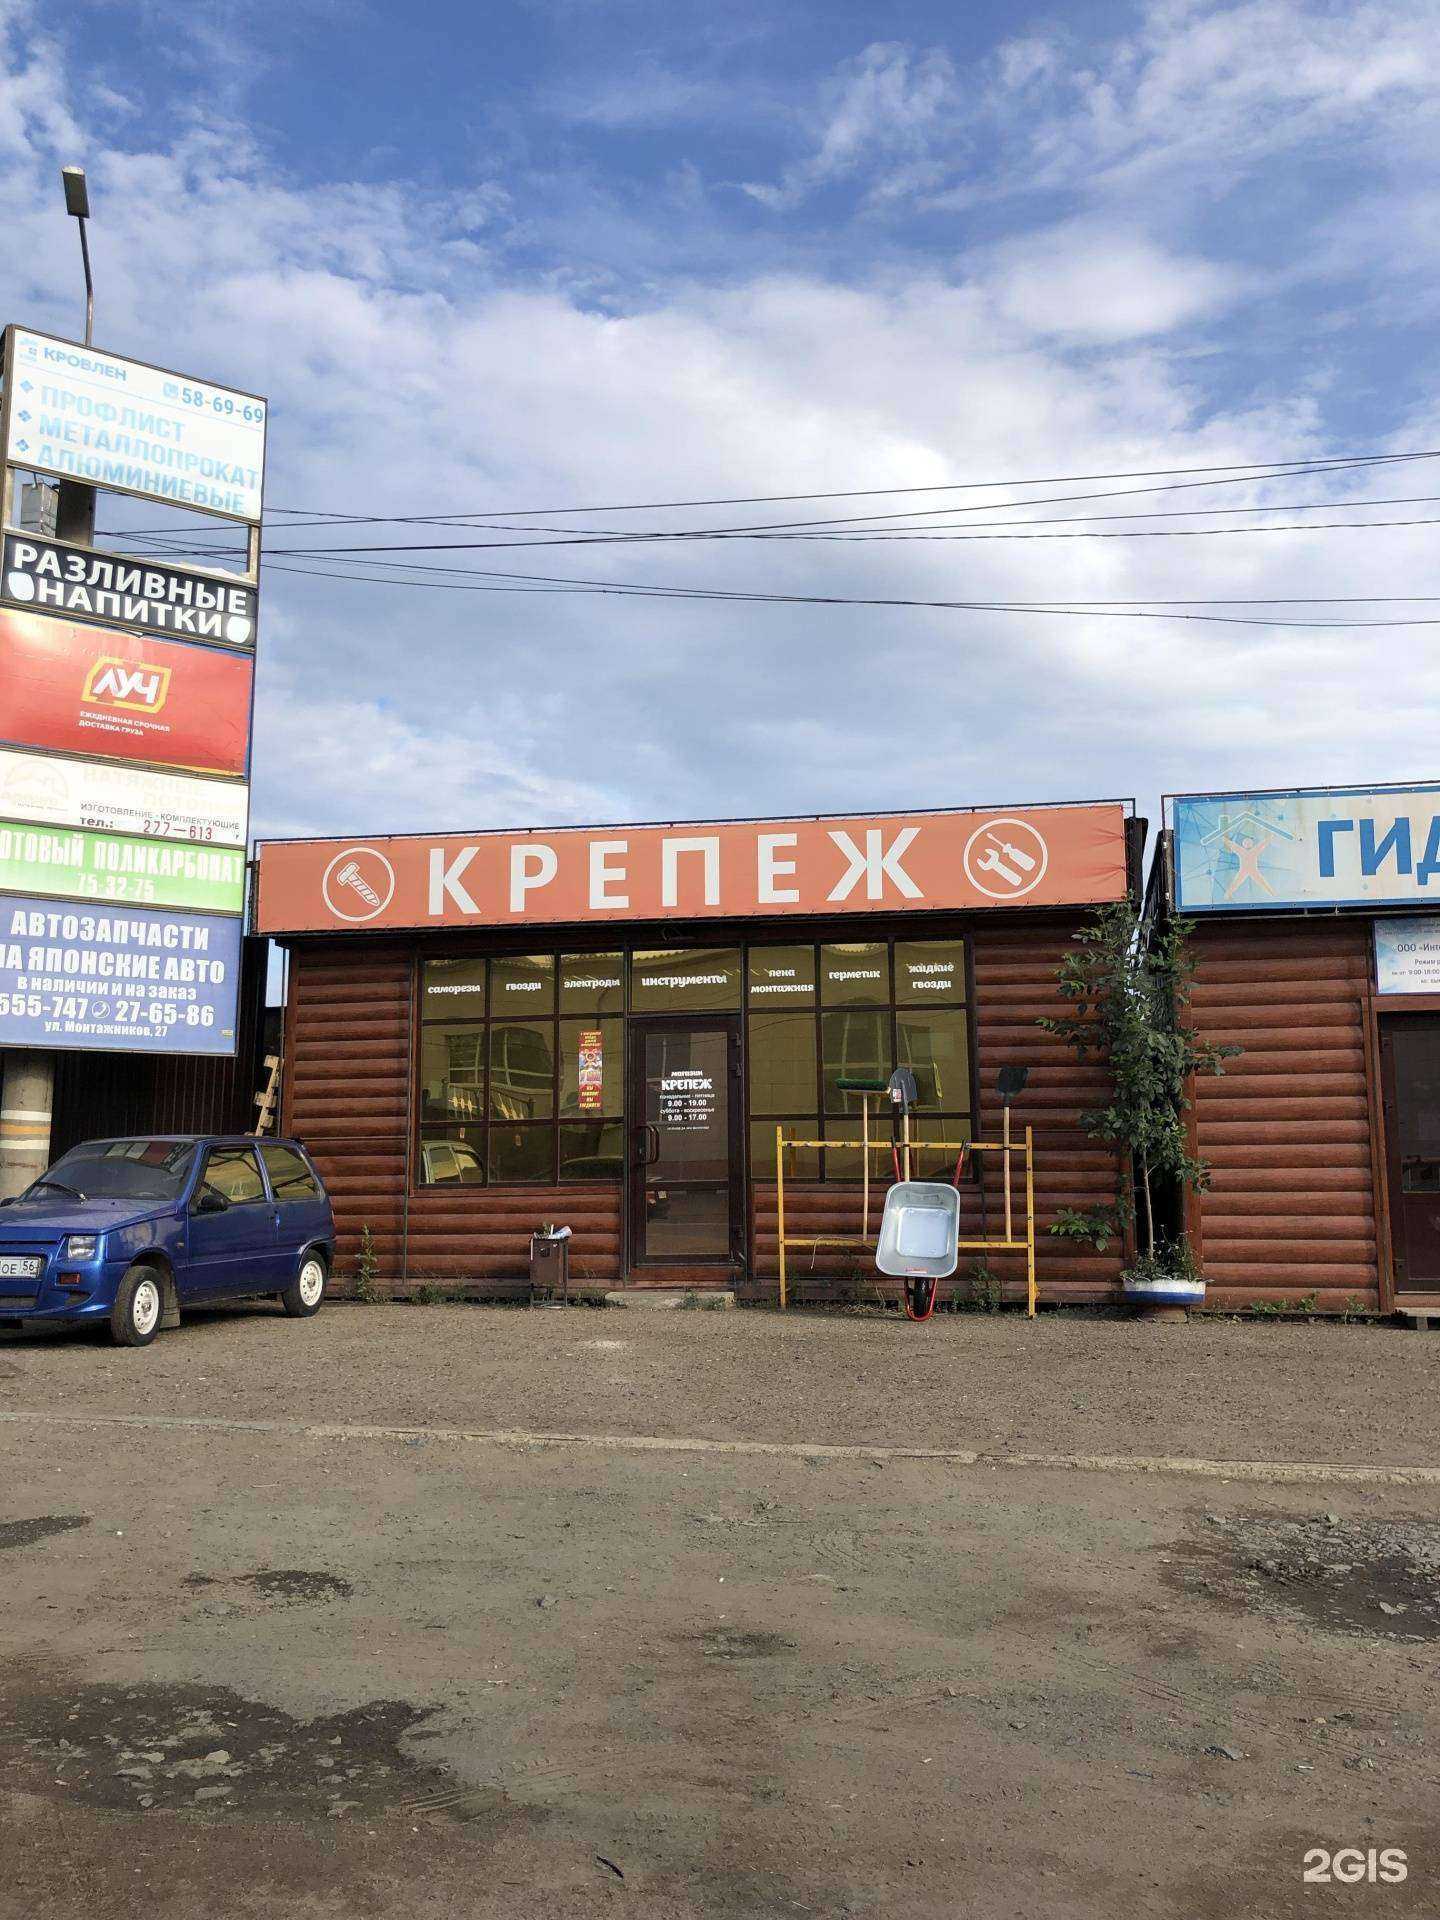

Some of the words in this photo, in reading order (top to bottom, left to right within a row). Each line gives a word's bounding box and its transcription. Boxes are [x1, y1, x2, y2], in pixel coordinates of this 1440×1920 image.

[44, 347, 127, 382] КРОВЛЕН
[41, 384, 186, 443] ПРОФЛИСТ
[182, 387, 263, 424] 58-69-69
[39, 414, 259, 491] МЕТАЛЛОПРОКАТ
[37, 444, 246, 515] АЛЮМИНИЕВЫЕ
[13, 542, 248, 616] РАЗЛИВНЫЕ
[37, 577, 223, 638] НАПИТКИ
[92, 667, 160, 704] ЛУЧ
[78, 719, 121, 733] ДОСТАВКА
[80, 803, 153, 819] ИЗГОТОВЛЕНИЕ
[160, 813, 240, 830] КОМПЛЕКТУЮЩИЕ
[94, 841, 243, 884] ПОЛИКАРБОНАТ
[428, 826, 925, 916] КРЕПЕЖ
[10, 910, 209, 951] АВТОЗАПЧАСТИ
[27, 946, 160, 980] ЯПОНСКИЕ
[164, 955, 225, 984] АВТО
[768, 968, 796, 978] пена
[828, 969, 881, 982] герметик
[31, 977, 109, 996] наличии
[126, 983, 145, 998] на
[148, 984, 197, 1000] заказ
[427, 983, 481, 995] саморезы
[505, 981, 542, 992] гвозди
[563, 977, 621, 991] электроды
[641, 974, 728, 989] инструменты
[750, 983, 815, 994] монтажная
[912, 980, 952, 991] гвозди
[115, 1001, 215, 1026] 27-65-86
[44, 1020, 62, 1033] ул.
[154, 1025, 168, 1037] 27
[661, 1079, 713, 1091] КРЕПЕЖ
[22, 1260, 35, 1271] 56
